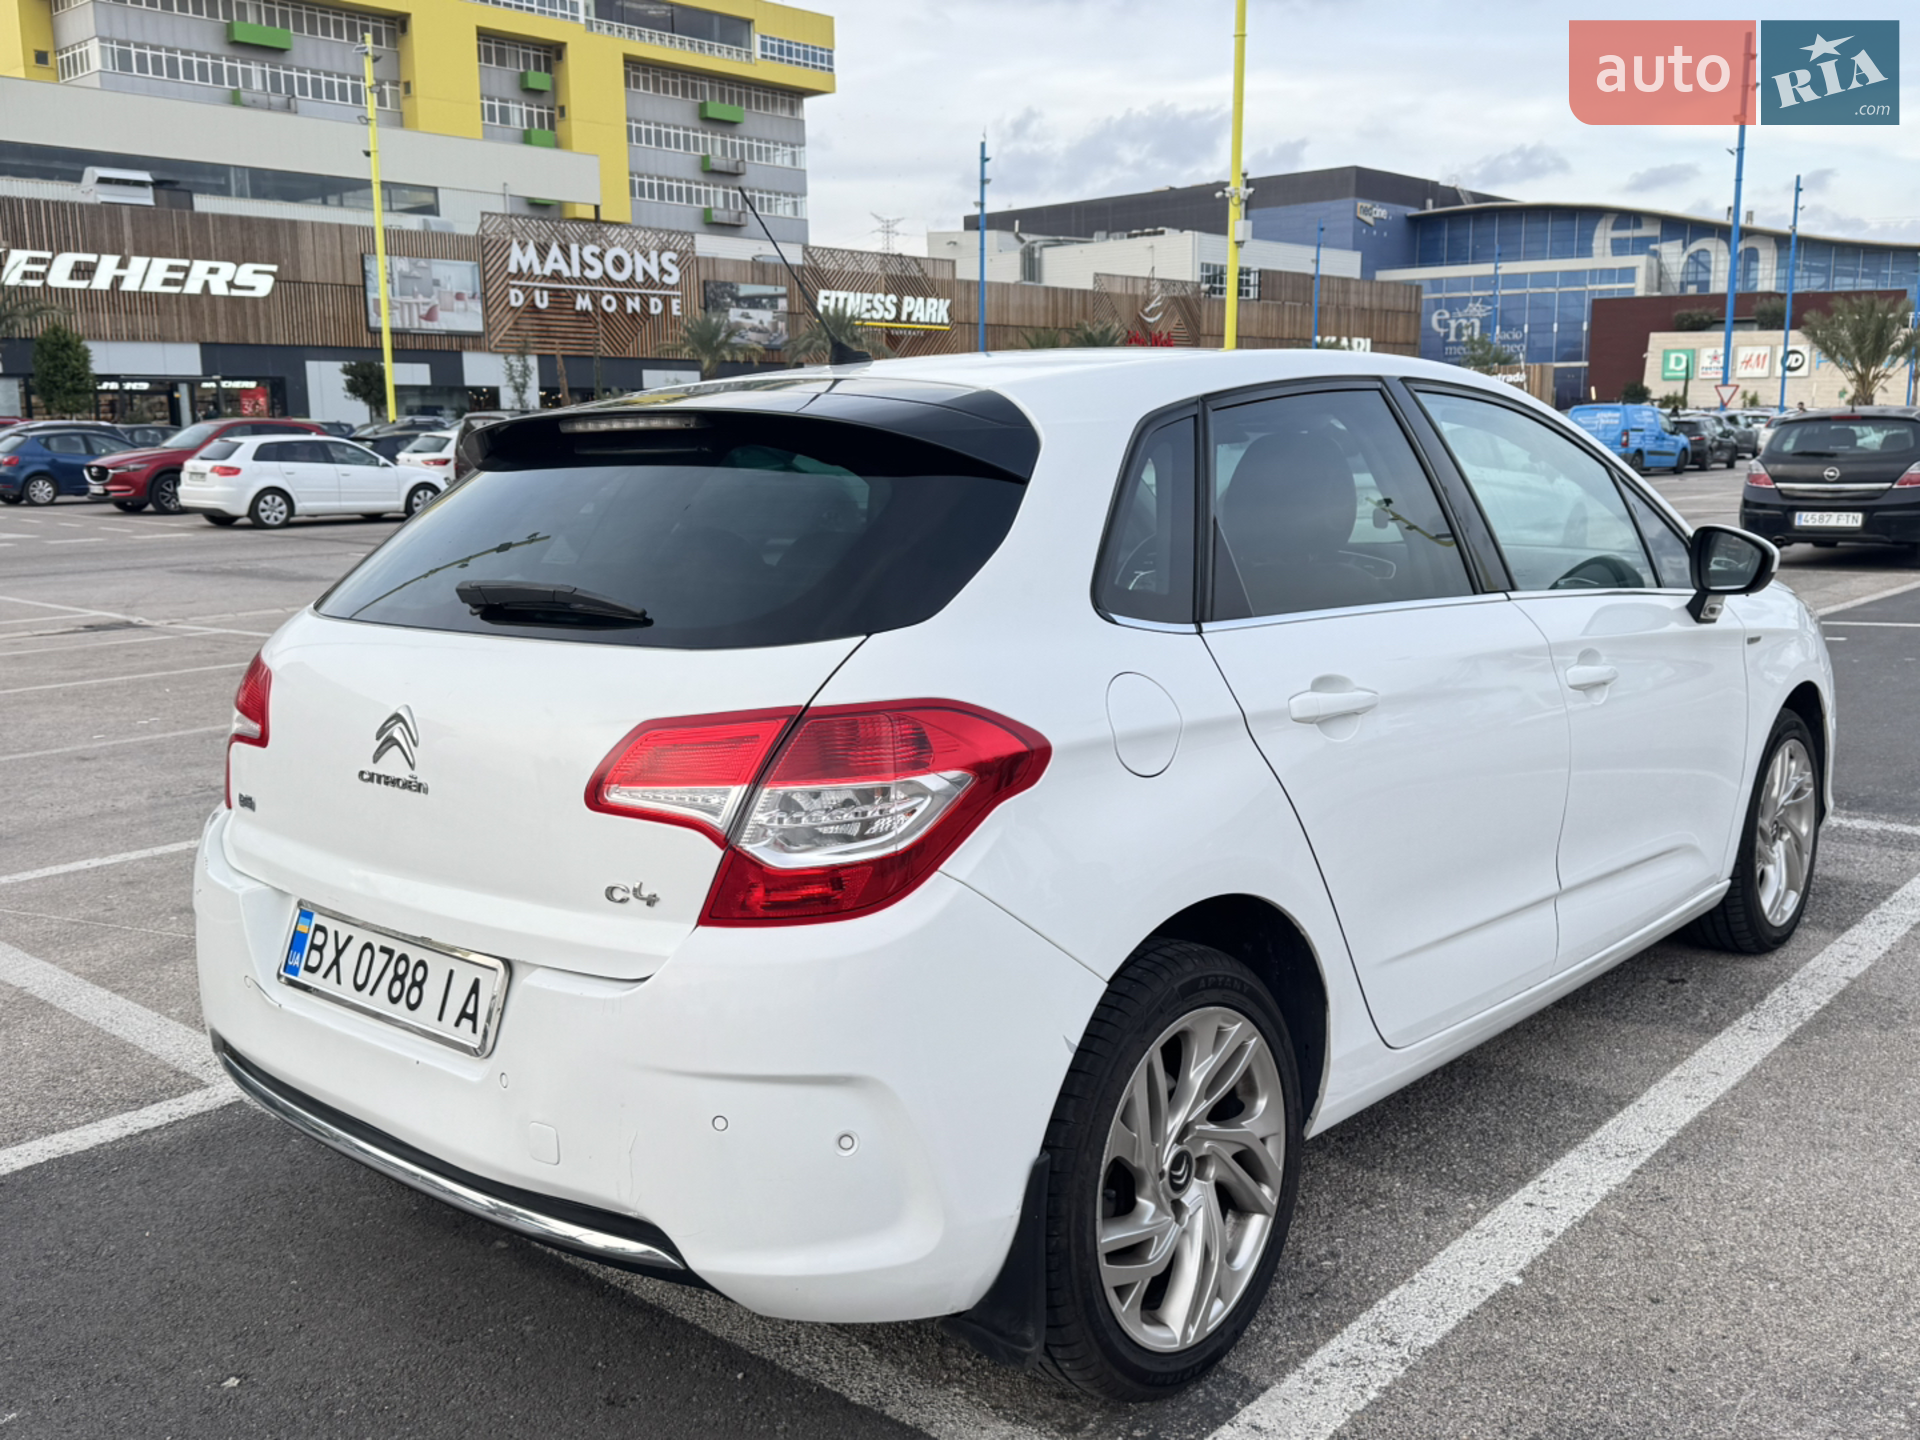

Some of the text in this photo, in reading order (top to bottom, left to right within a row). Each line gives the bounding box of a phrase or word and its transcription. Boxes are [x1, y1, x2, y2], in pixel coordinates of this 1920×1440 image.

[0, 247, 278, 297] ECHERS
[508, 238, 681, 285] MAISONS
[509, 288, 682, 316] DU MONDE
[817, 289, 951, 324] FITNESS PARK
[1669, 353, 1687, 371] D
[1803, 514, 1860, 525] 4587 FTN
[604, 881, 661, 907] C4
[287, 950, 301, 968] UA
[303, 923, 481, 1034] BX 0788 IA
